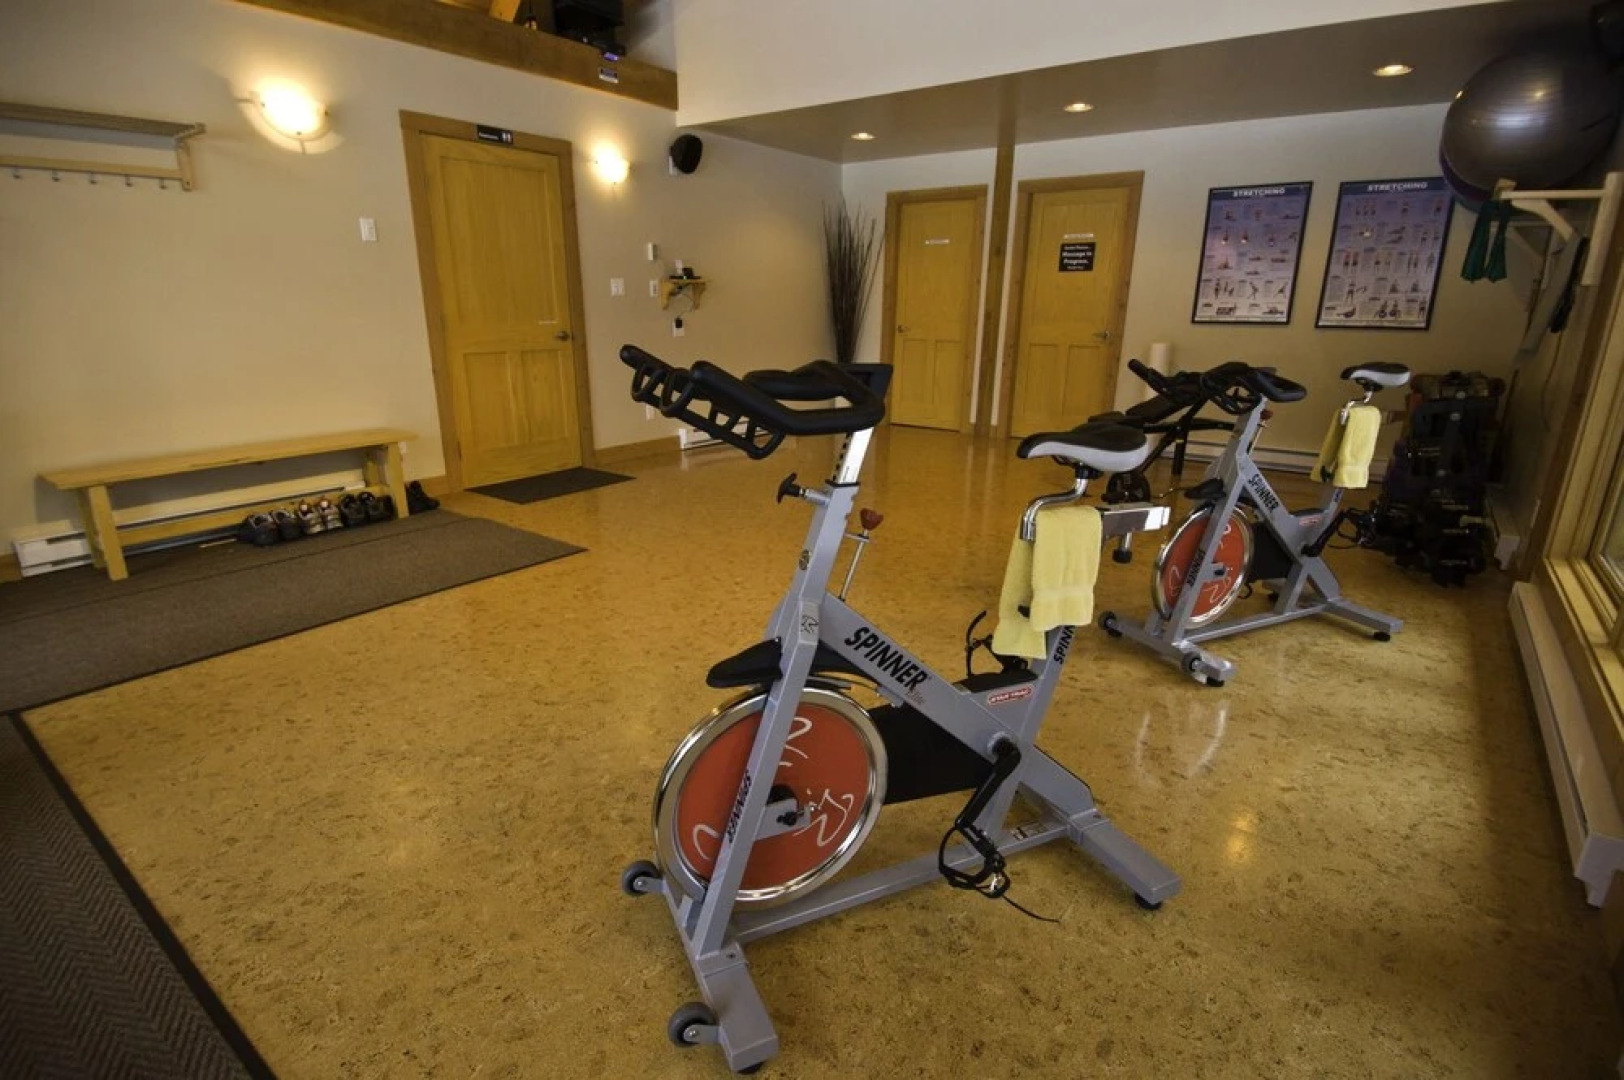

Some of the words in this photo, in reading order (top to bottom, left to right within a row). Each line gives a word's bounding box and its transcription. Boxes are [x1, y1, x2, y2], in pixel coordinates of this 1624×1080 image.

[1233, 187, 1285, 197] STRETCHING
[1367, 181, 1428, 192] STRETCHING
[1248, 473, 1279, 513] SPINNER
[844, 626, 928, 693] SPINNER
